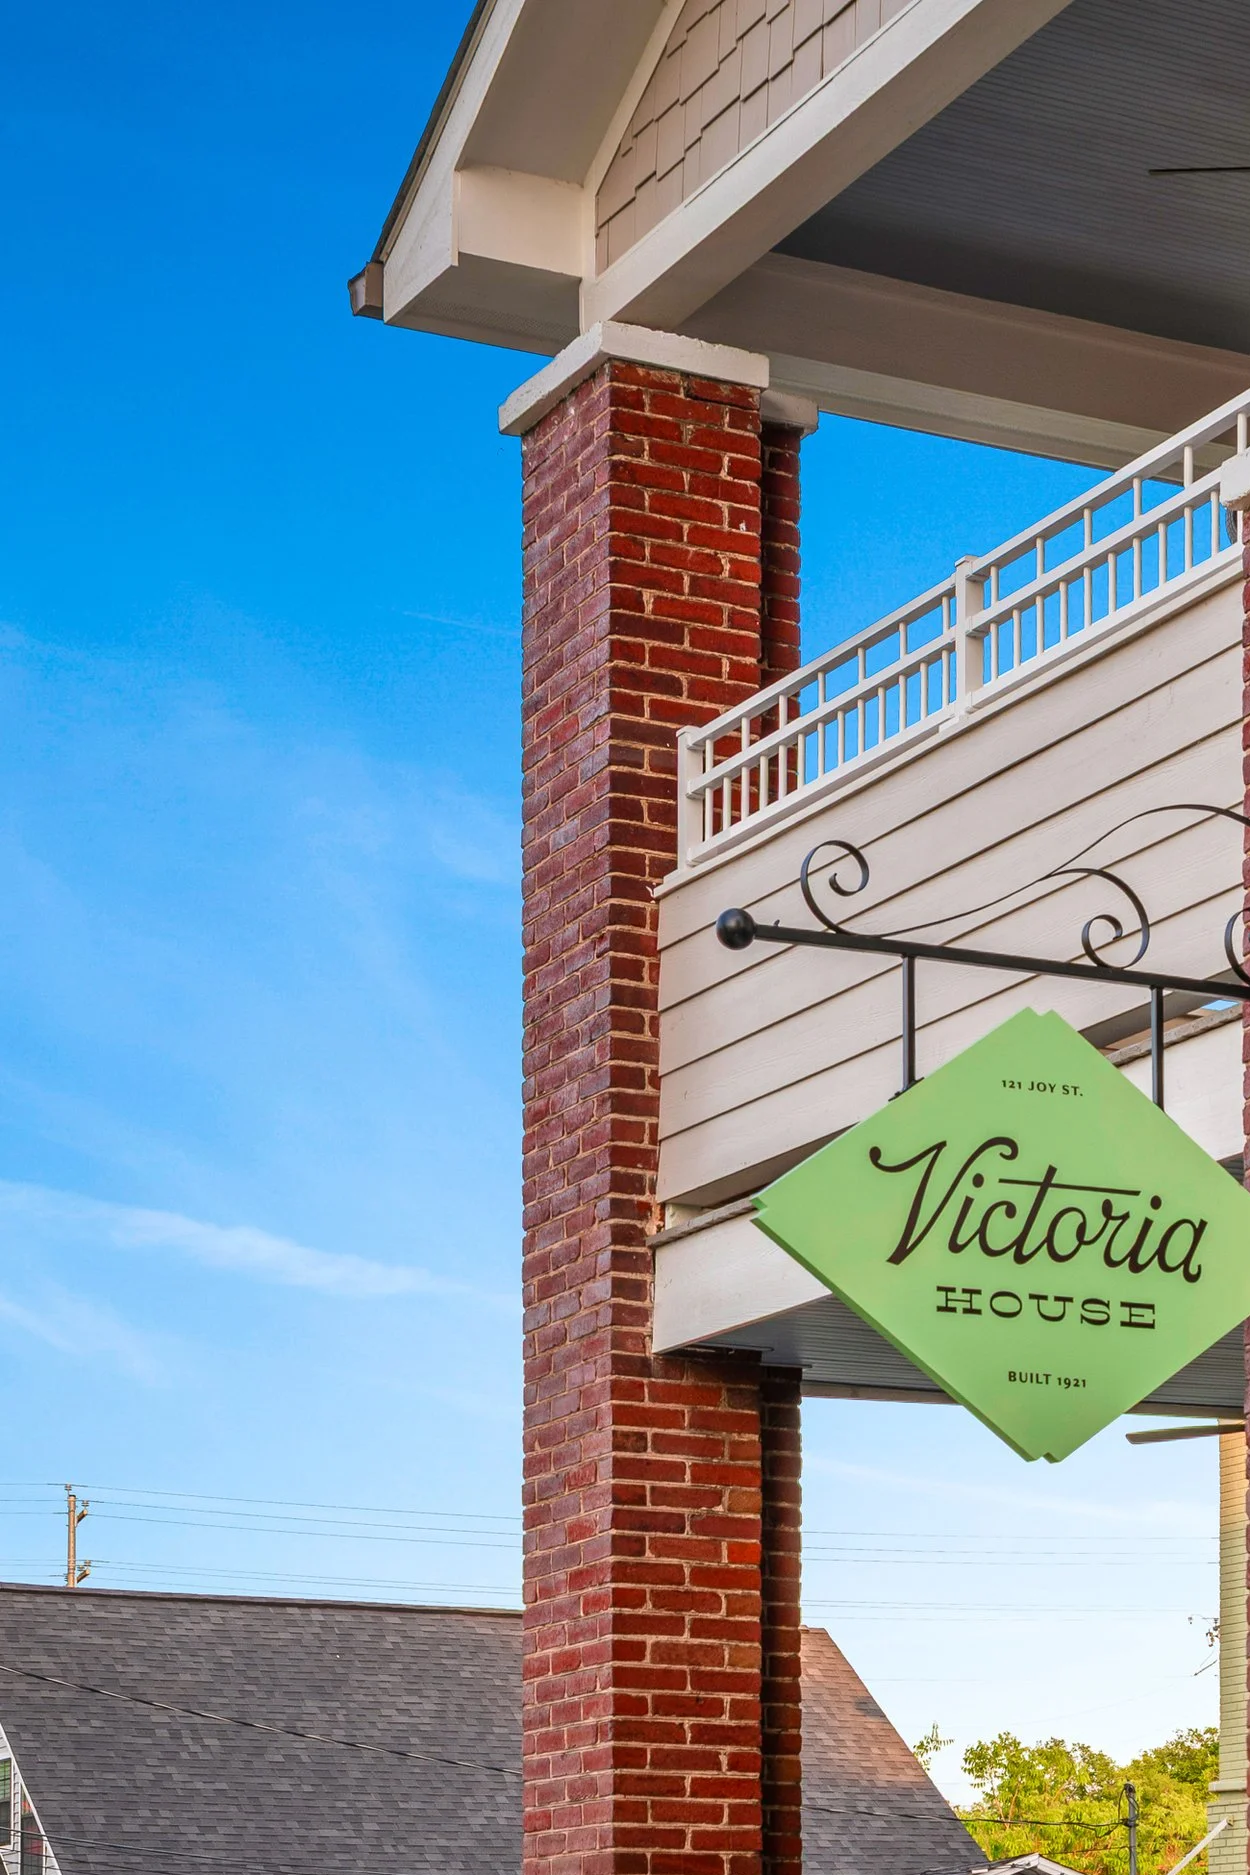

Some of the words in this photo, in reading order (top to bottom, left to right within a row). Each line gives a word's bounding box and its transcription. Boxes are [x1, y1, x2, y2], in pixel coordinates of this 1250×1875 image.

[1001, 1079, 1022, 1090] 121
[1027, 1080, 1057, 1093] JOY
[1061, 1084, 1084, 1097] ST.
[868, 1136, 1208, 1284] Victoria
[936, 1285, 1157, 1330] HOUSE
[1007, 1370, 1053, 1386] BUILT
[1056, 1376, 1087, 1390] 1921
